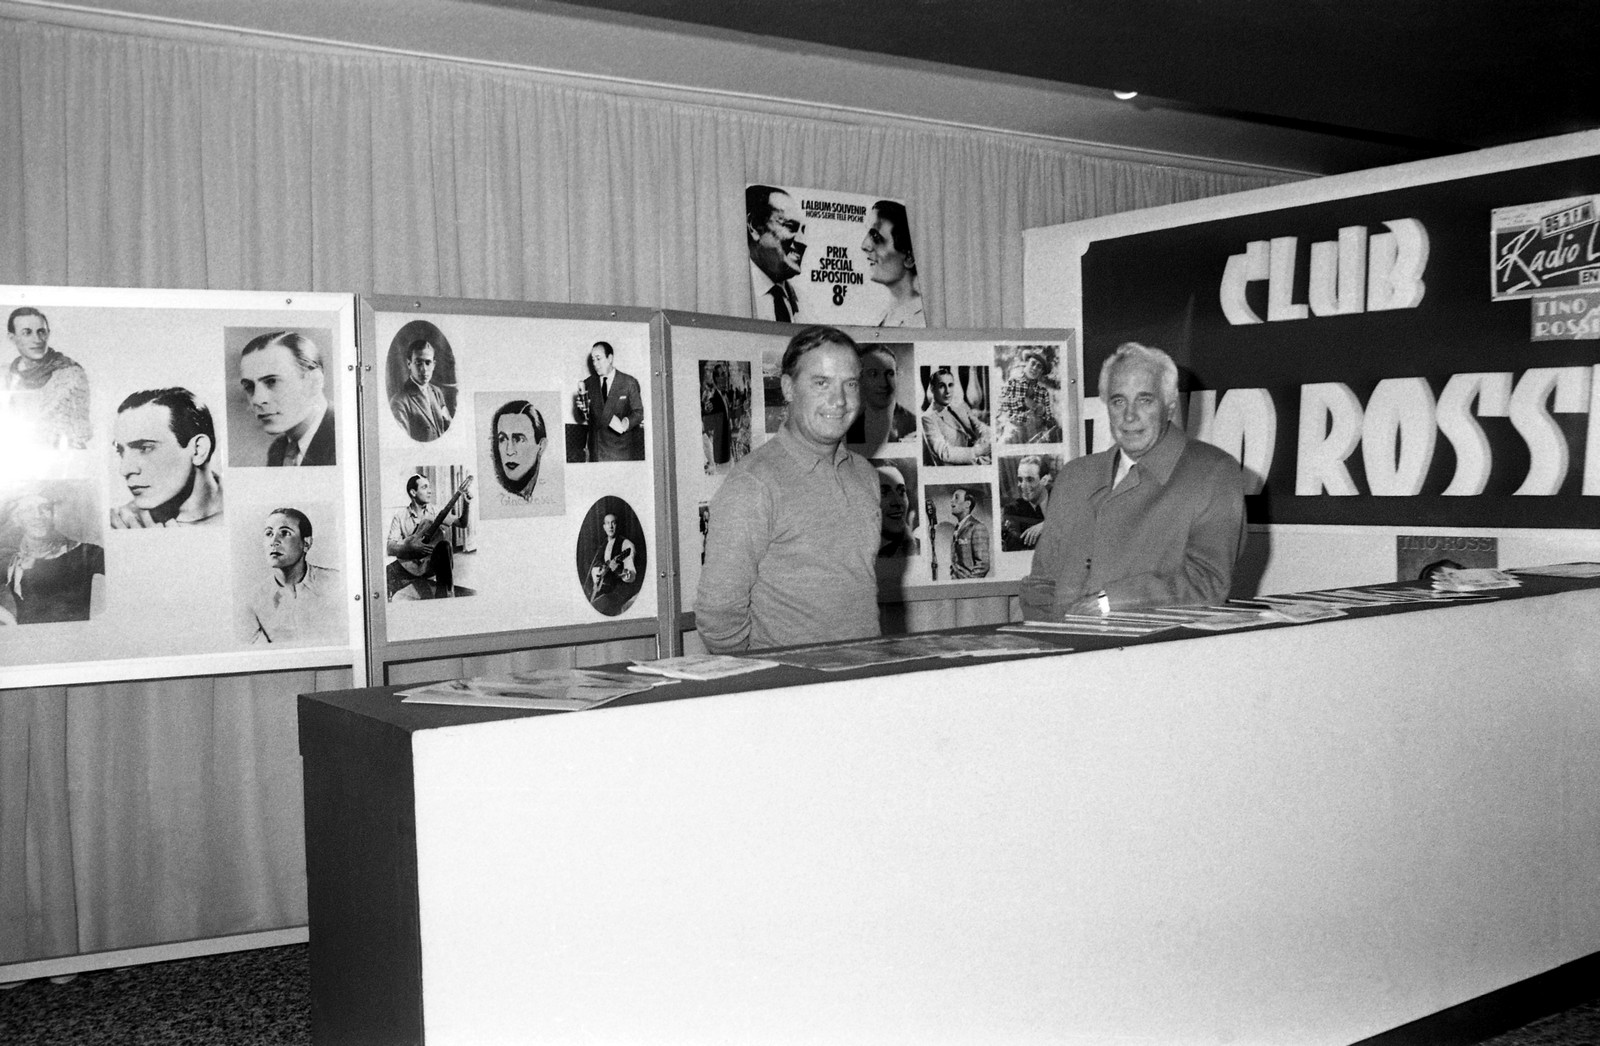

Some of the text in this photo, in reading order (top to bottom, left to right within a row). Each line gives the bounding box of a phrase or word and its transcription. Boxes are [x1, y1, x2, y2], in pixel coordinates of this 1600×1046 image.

[847, 214, 864, 223] POCHE
[827, 246, 848, 258] PRIX
[1496, 225, 1580, 288] Radio
[820, 258, 853, 271] SPECIAL
[1219, 218, 1430, 326] CLUB
[811, 270, 863, 285] EXPOSITION
[1536, 298, 1588, 317] TINO
[1441, 537, 1497, 552] ROSSI
